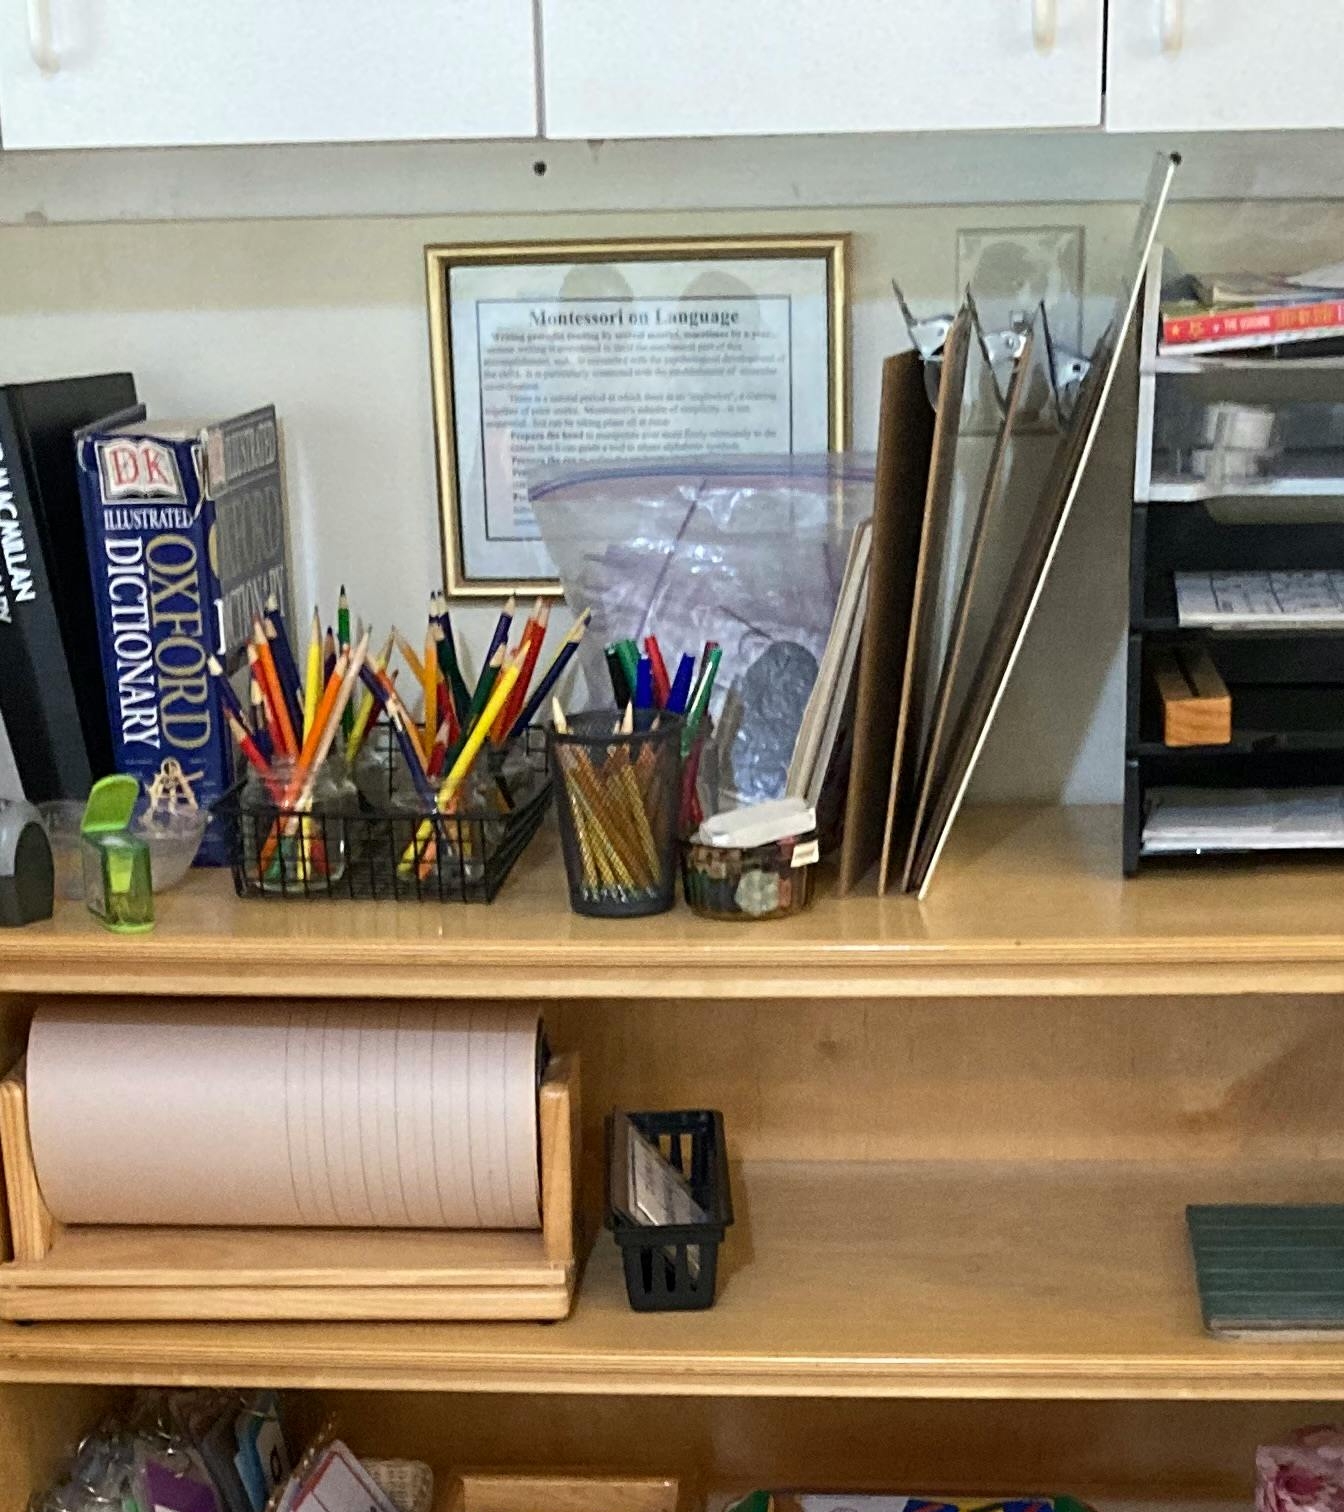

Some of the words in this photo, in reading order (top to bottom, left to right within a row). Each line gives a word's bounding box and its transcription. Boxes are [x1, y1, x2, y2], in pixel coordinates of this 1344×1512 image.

[529, 308, 623, 327] Montessori
[629, 313, 650, 326] on
[655, 308, 740, 328] Language
[108, 441, 171, 487] DK
[103, 507, 194, 530] ILLUSTRATED
[105, 536, 161, 750] DICTIONARY
[145, 533, 212, 750] OXFORD
